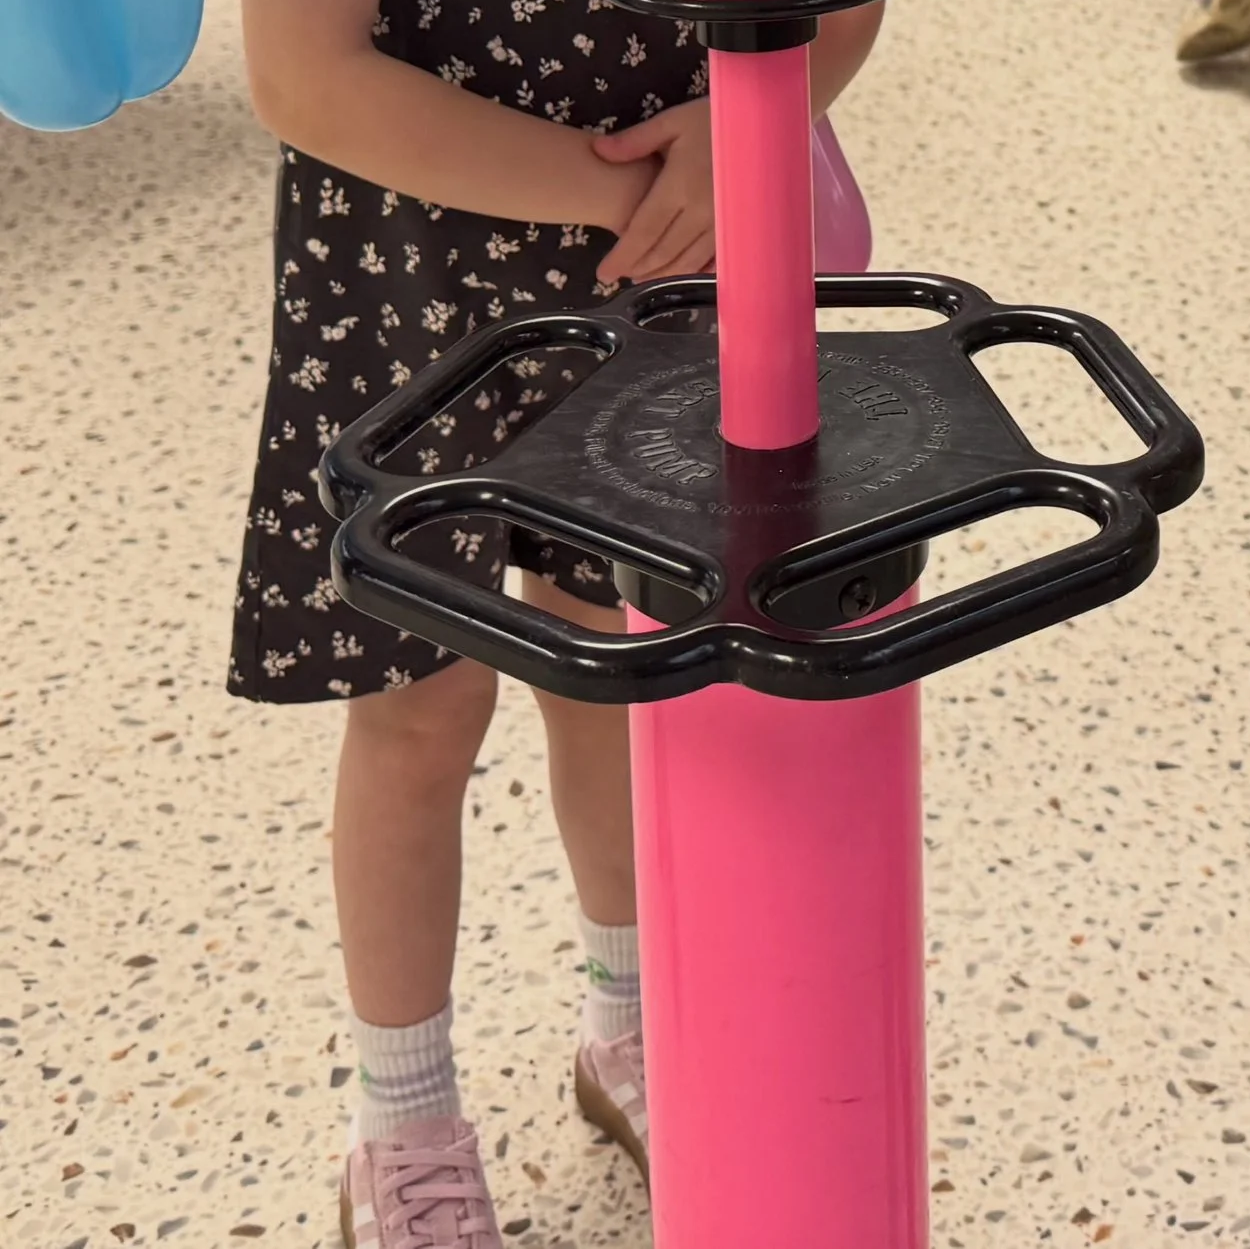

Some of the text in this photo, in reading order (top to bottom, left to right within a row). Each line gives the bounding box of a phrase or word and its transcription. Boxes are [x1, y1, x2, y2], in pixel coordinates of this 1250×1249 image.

[838, 377, 908, 421] THE
[626, 426, 719, 486] PUMP
[852, 454, 886, 473] USA
[859, 471, 902, 494] New
